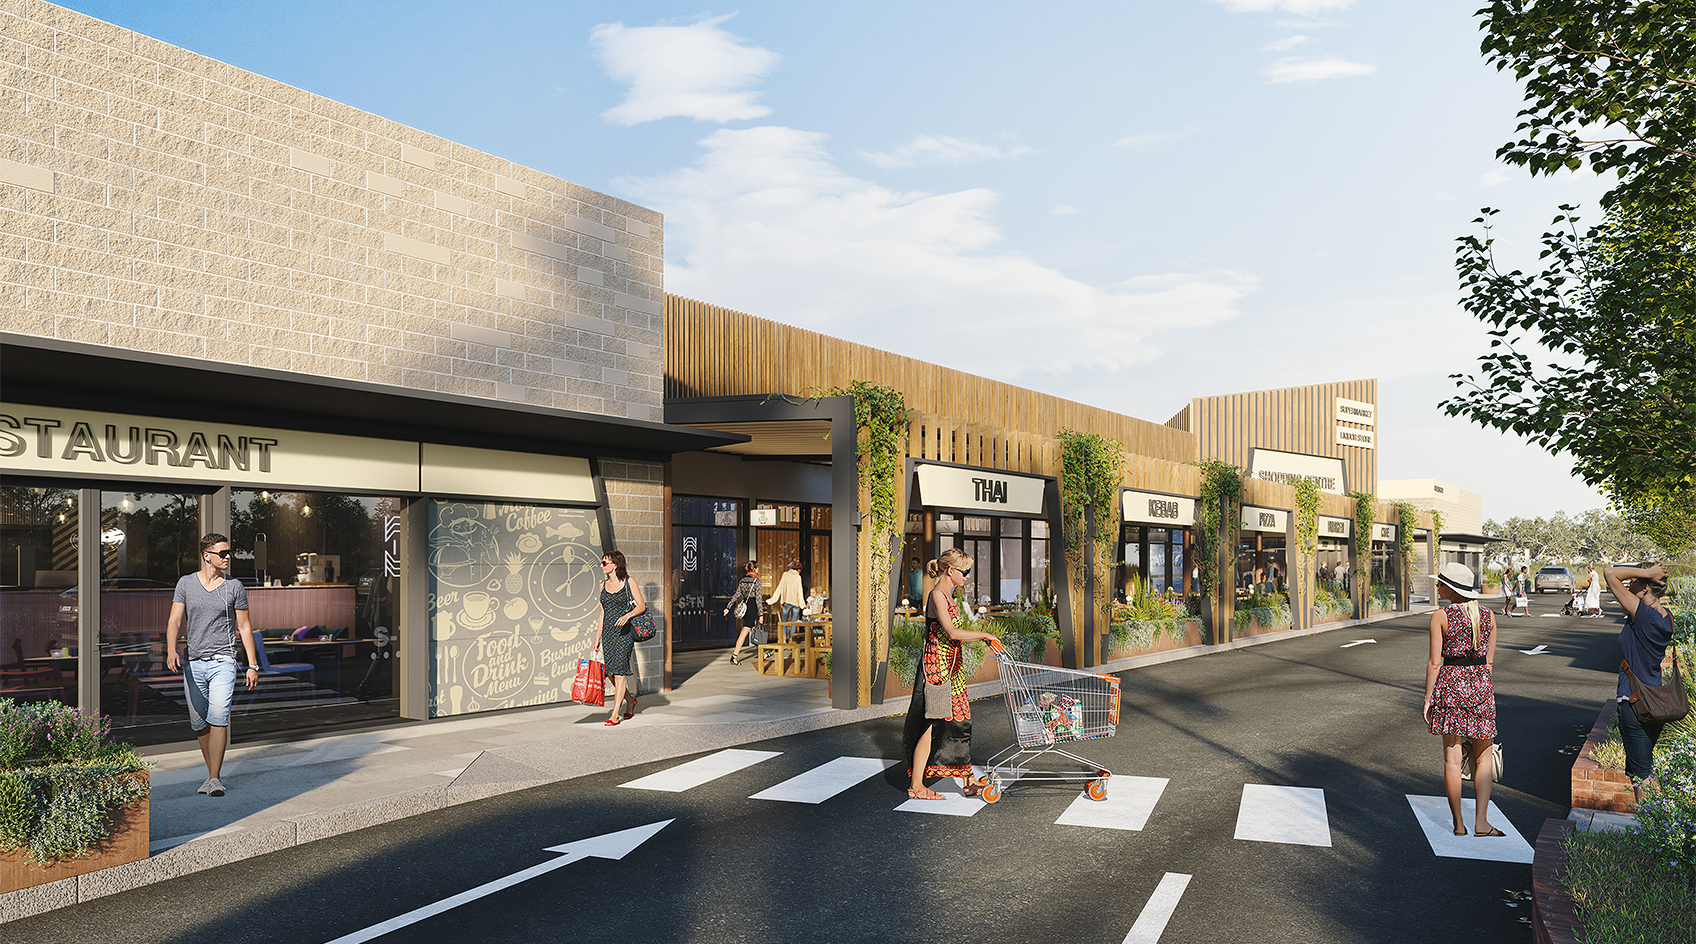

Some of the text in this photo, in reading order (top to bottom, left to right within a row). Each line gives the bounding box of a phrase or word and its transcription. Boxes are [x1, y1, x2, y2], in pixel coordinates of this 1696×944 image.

[0, 414, 278, 473] STAURANT
[971, 477, 1008, 504] THAI
[505, 507, 553, 532] Coffee
[1148, 499, 1179, 519] KEBAB
[1258, 512, 1276, 528] PIZZA
[476, 624, 523, 661] Food
[540, 637, 593, 668] Business
[488, 646, 514, 668] and
[469, 652, 530, 689] Drink
[483, 676, 523, 699] Menu
